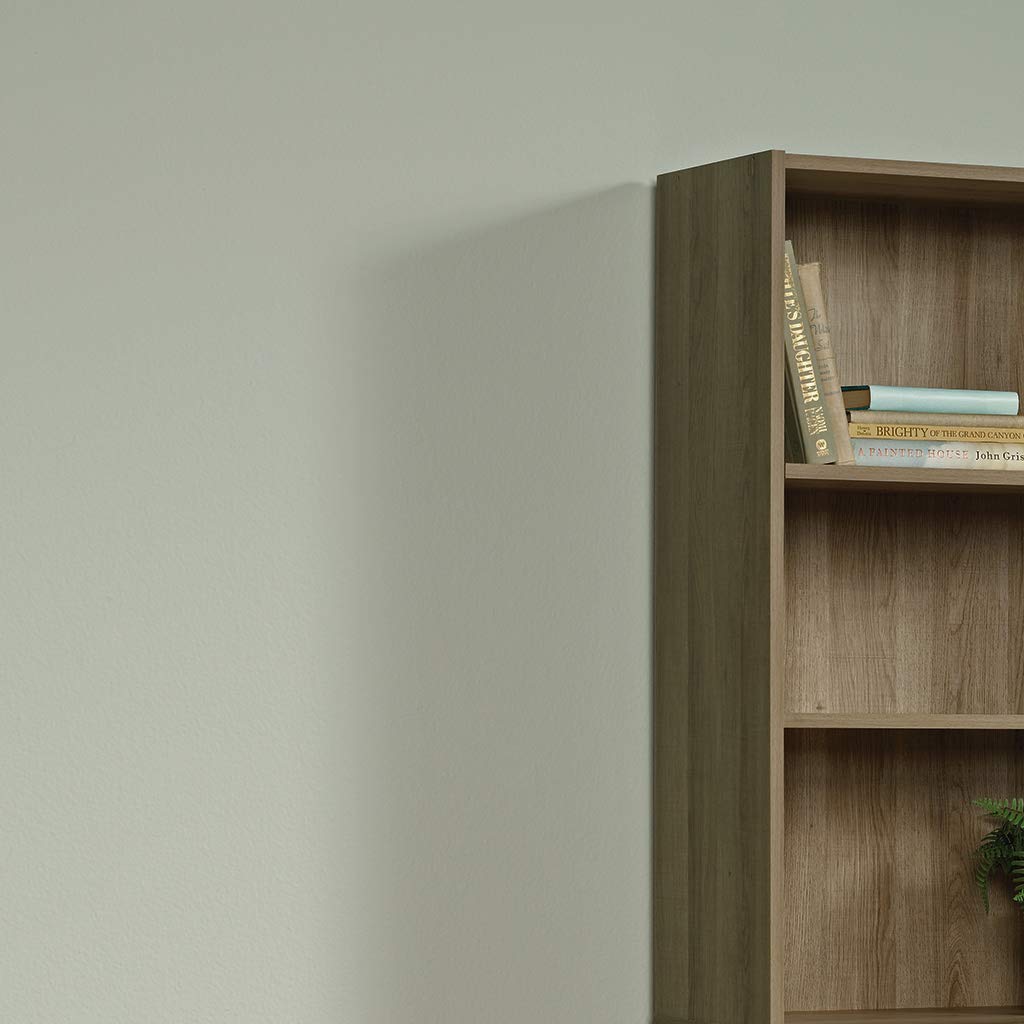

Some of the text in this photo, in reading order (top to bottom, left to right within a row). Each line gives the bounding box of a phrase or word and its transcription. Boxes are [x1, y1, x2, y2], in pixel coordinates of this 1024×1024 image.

[789, 322, 819, 404] DAUGHTER
[876, 426, 929, 438] BRIGHTY
[930, 429, 940, 437] OF
[958, 431, 986, 439] GRAND
[987, 432, 1021, 440] CANYON
[858, 447, 968, 459] A PAINTED HOUSE
[975, 451, 1000, 461] John
